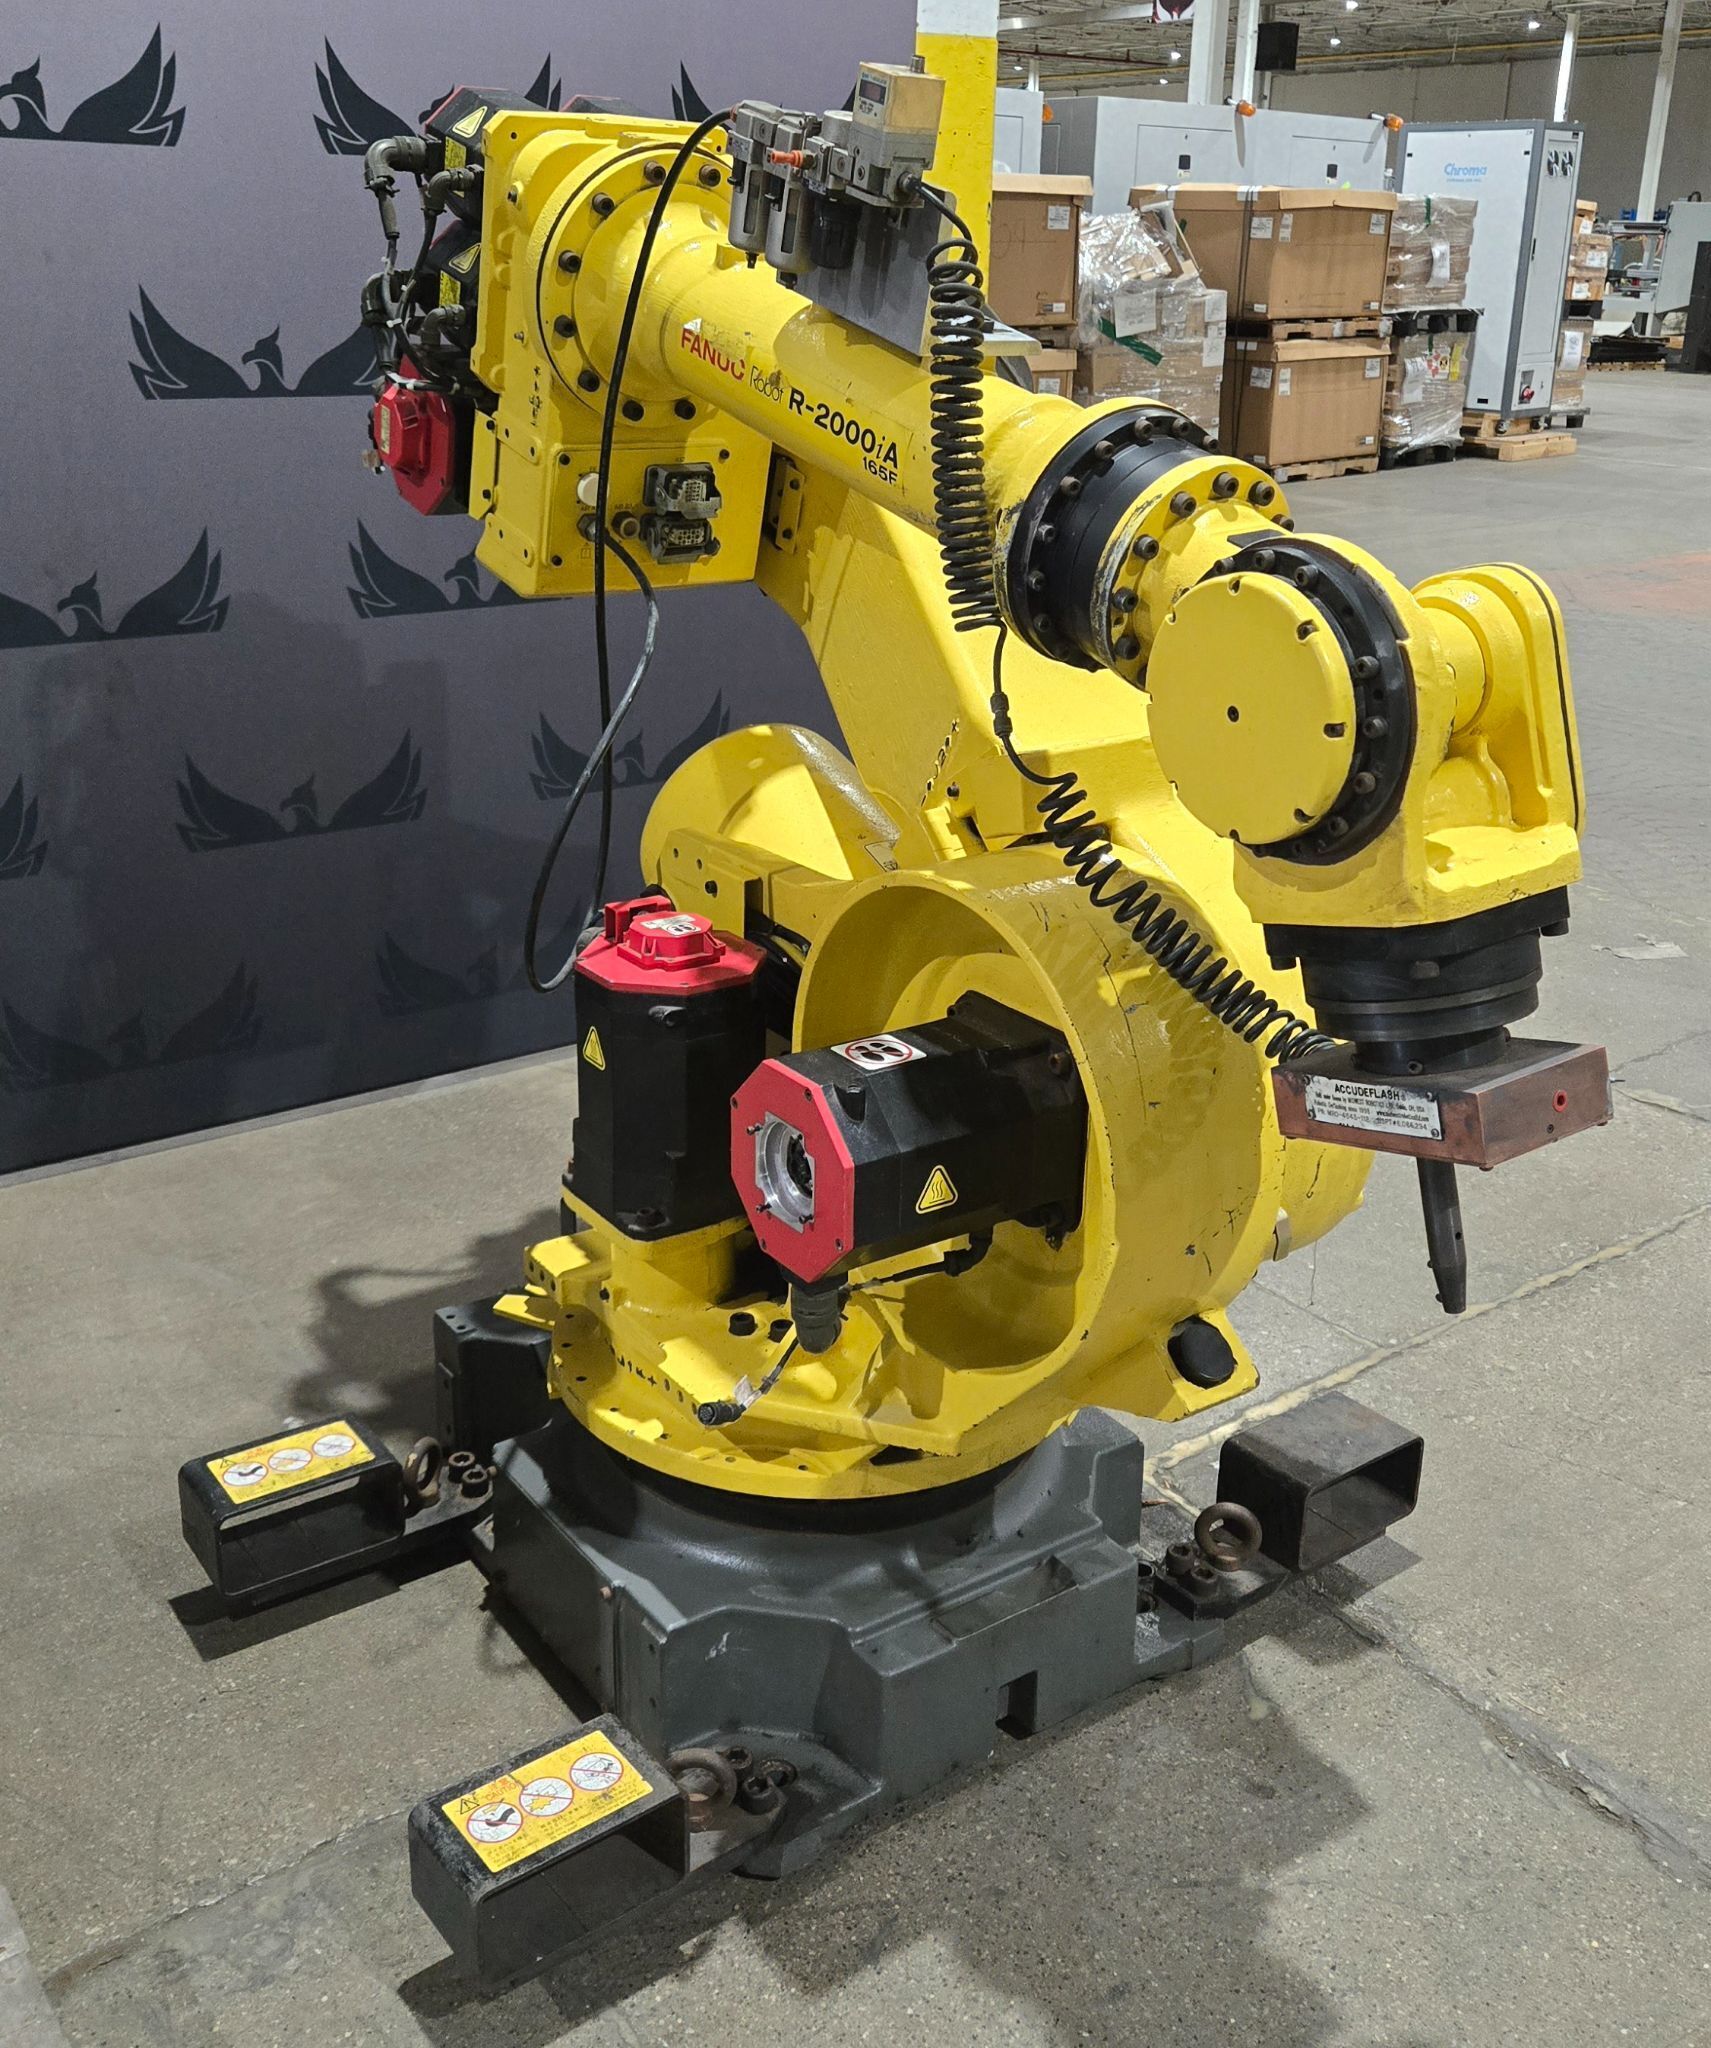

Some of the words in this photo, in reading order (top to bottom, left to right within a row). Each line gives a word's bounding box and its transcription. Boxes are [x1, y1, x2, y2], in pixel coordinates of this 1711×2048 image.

[1444, 162, 1488, 177] Chroma
[681, 328, 746, 381] FANUC
[750, 365, 784, 403] Robot
[789, 387, 898, 469] R-2000iA
[863, 456, 898, 485] 165F
